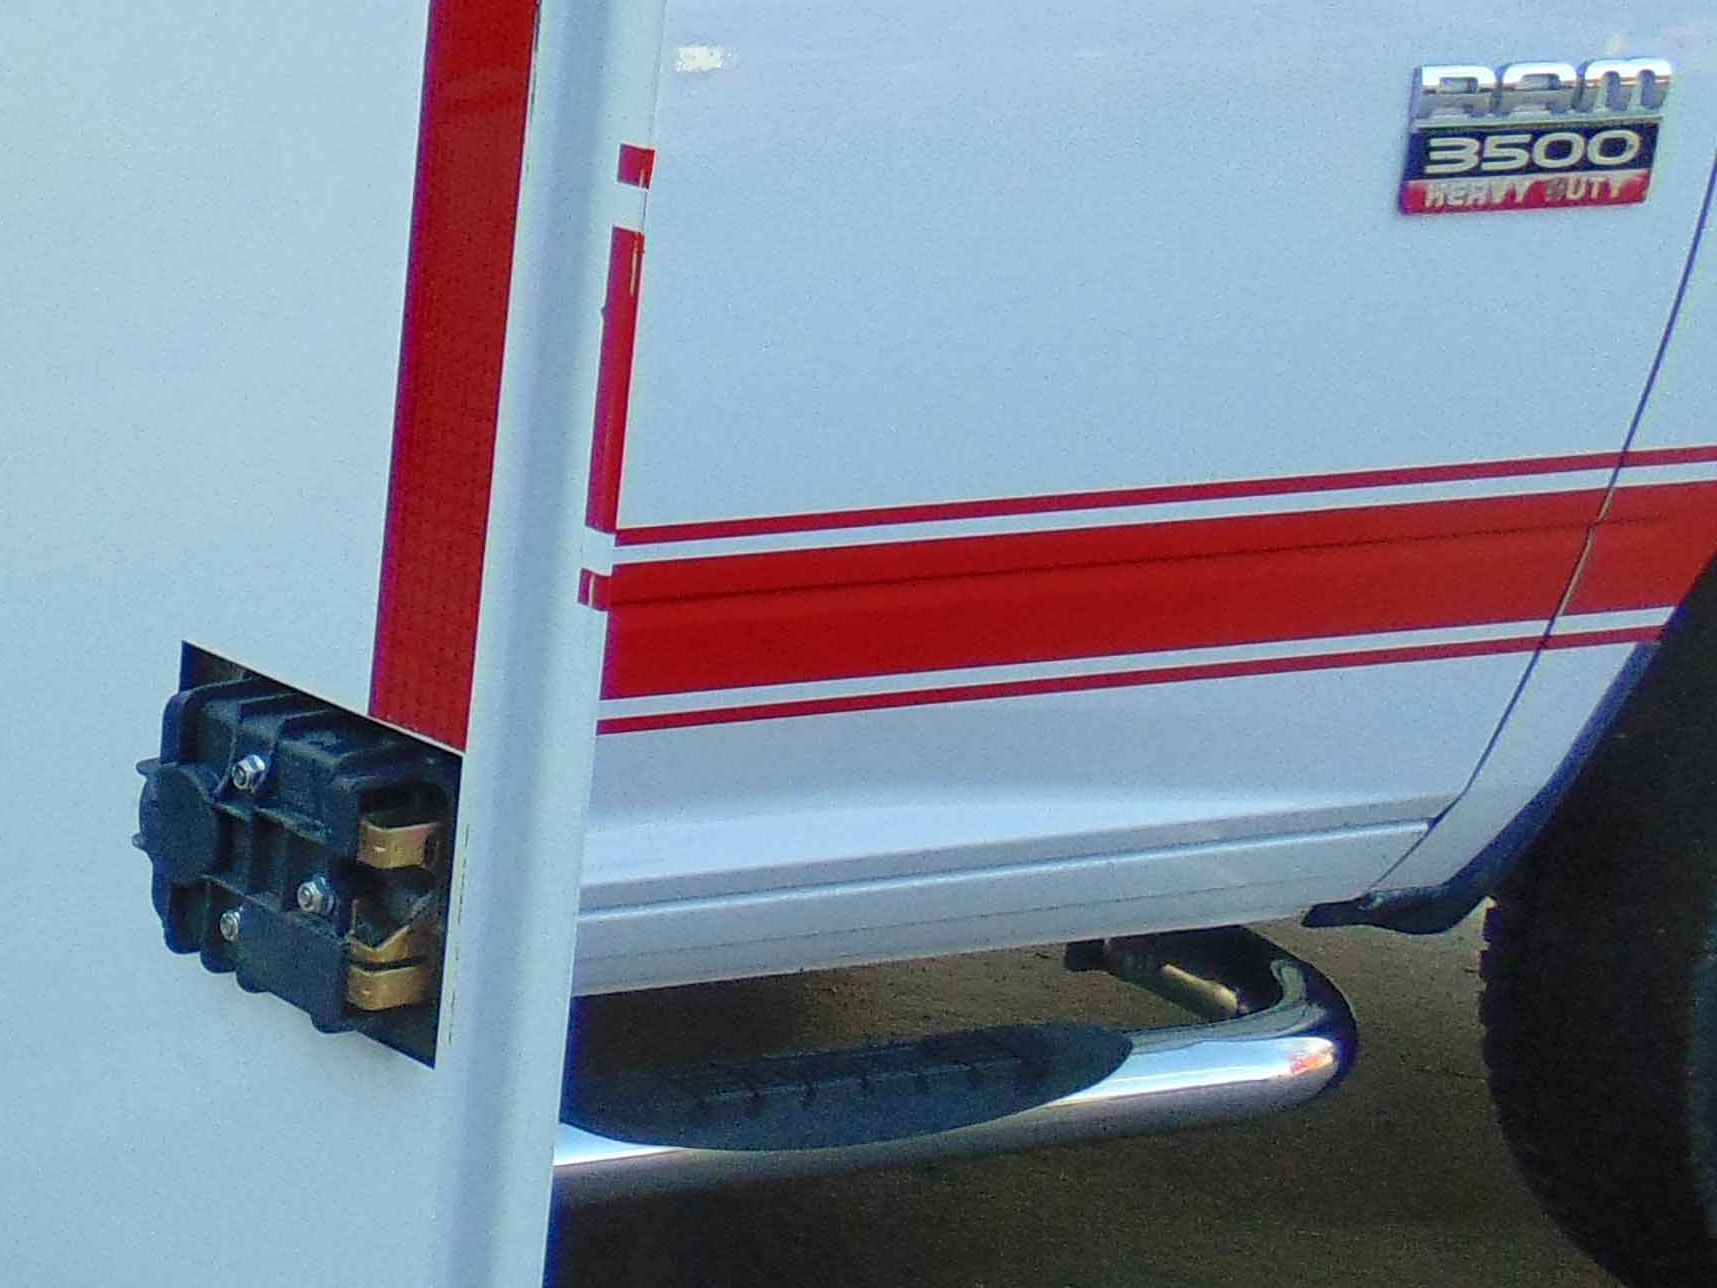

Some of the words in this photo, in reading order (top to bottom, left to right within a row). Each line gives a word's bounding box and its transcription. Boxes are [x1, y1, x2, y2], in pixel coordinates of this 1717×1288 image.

[1413, 58, 1672, 119] RAM
[1423, 129, 1641, 174] 3500
[1423, 178, 1535, 208] HEAVY
[1543, 175, 1626, 202] DUTY
